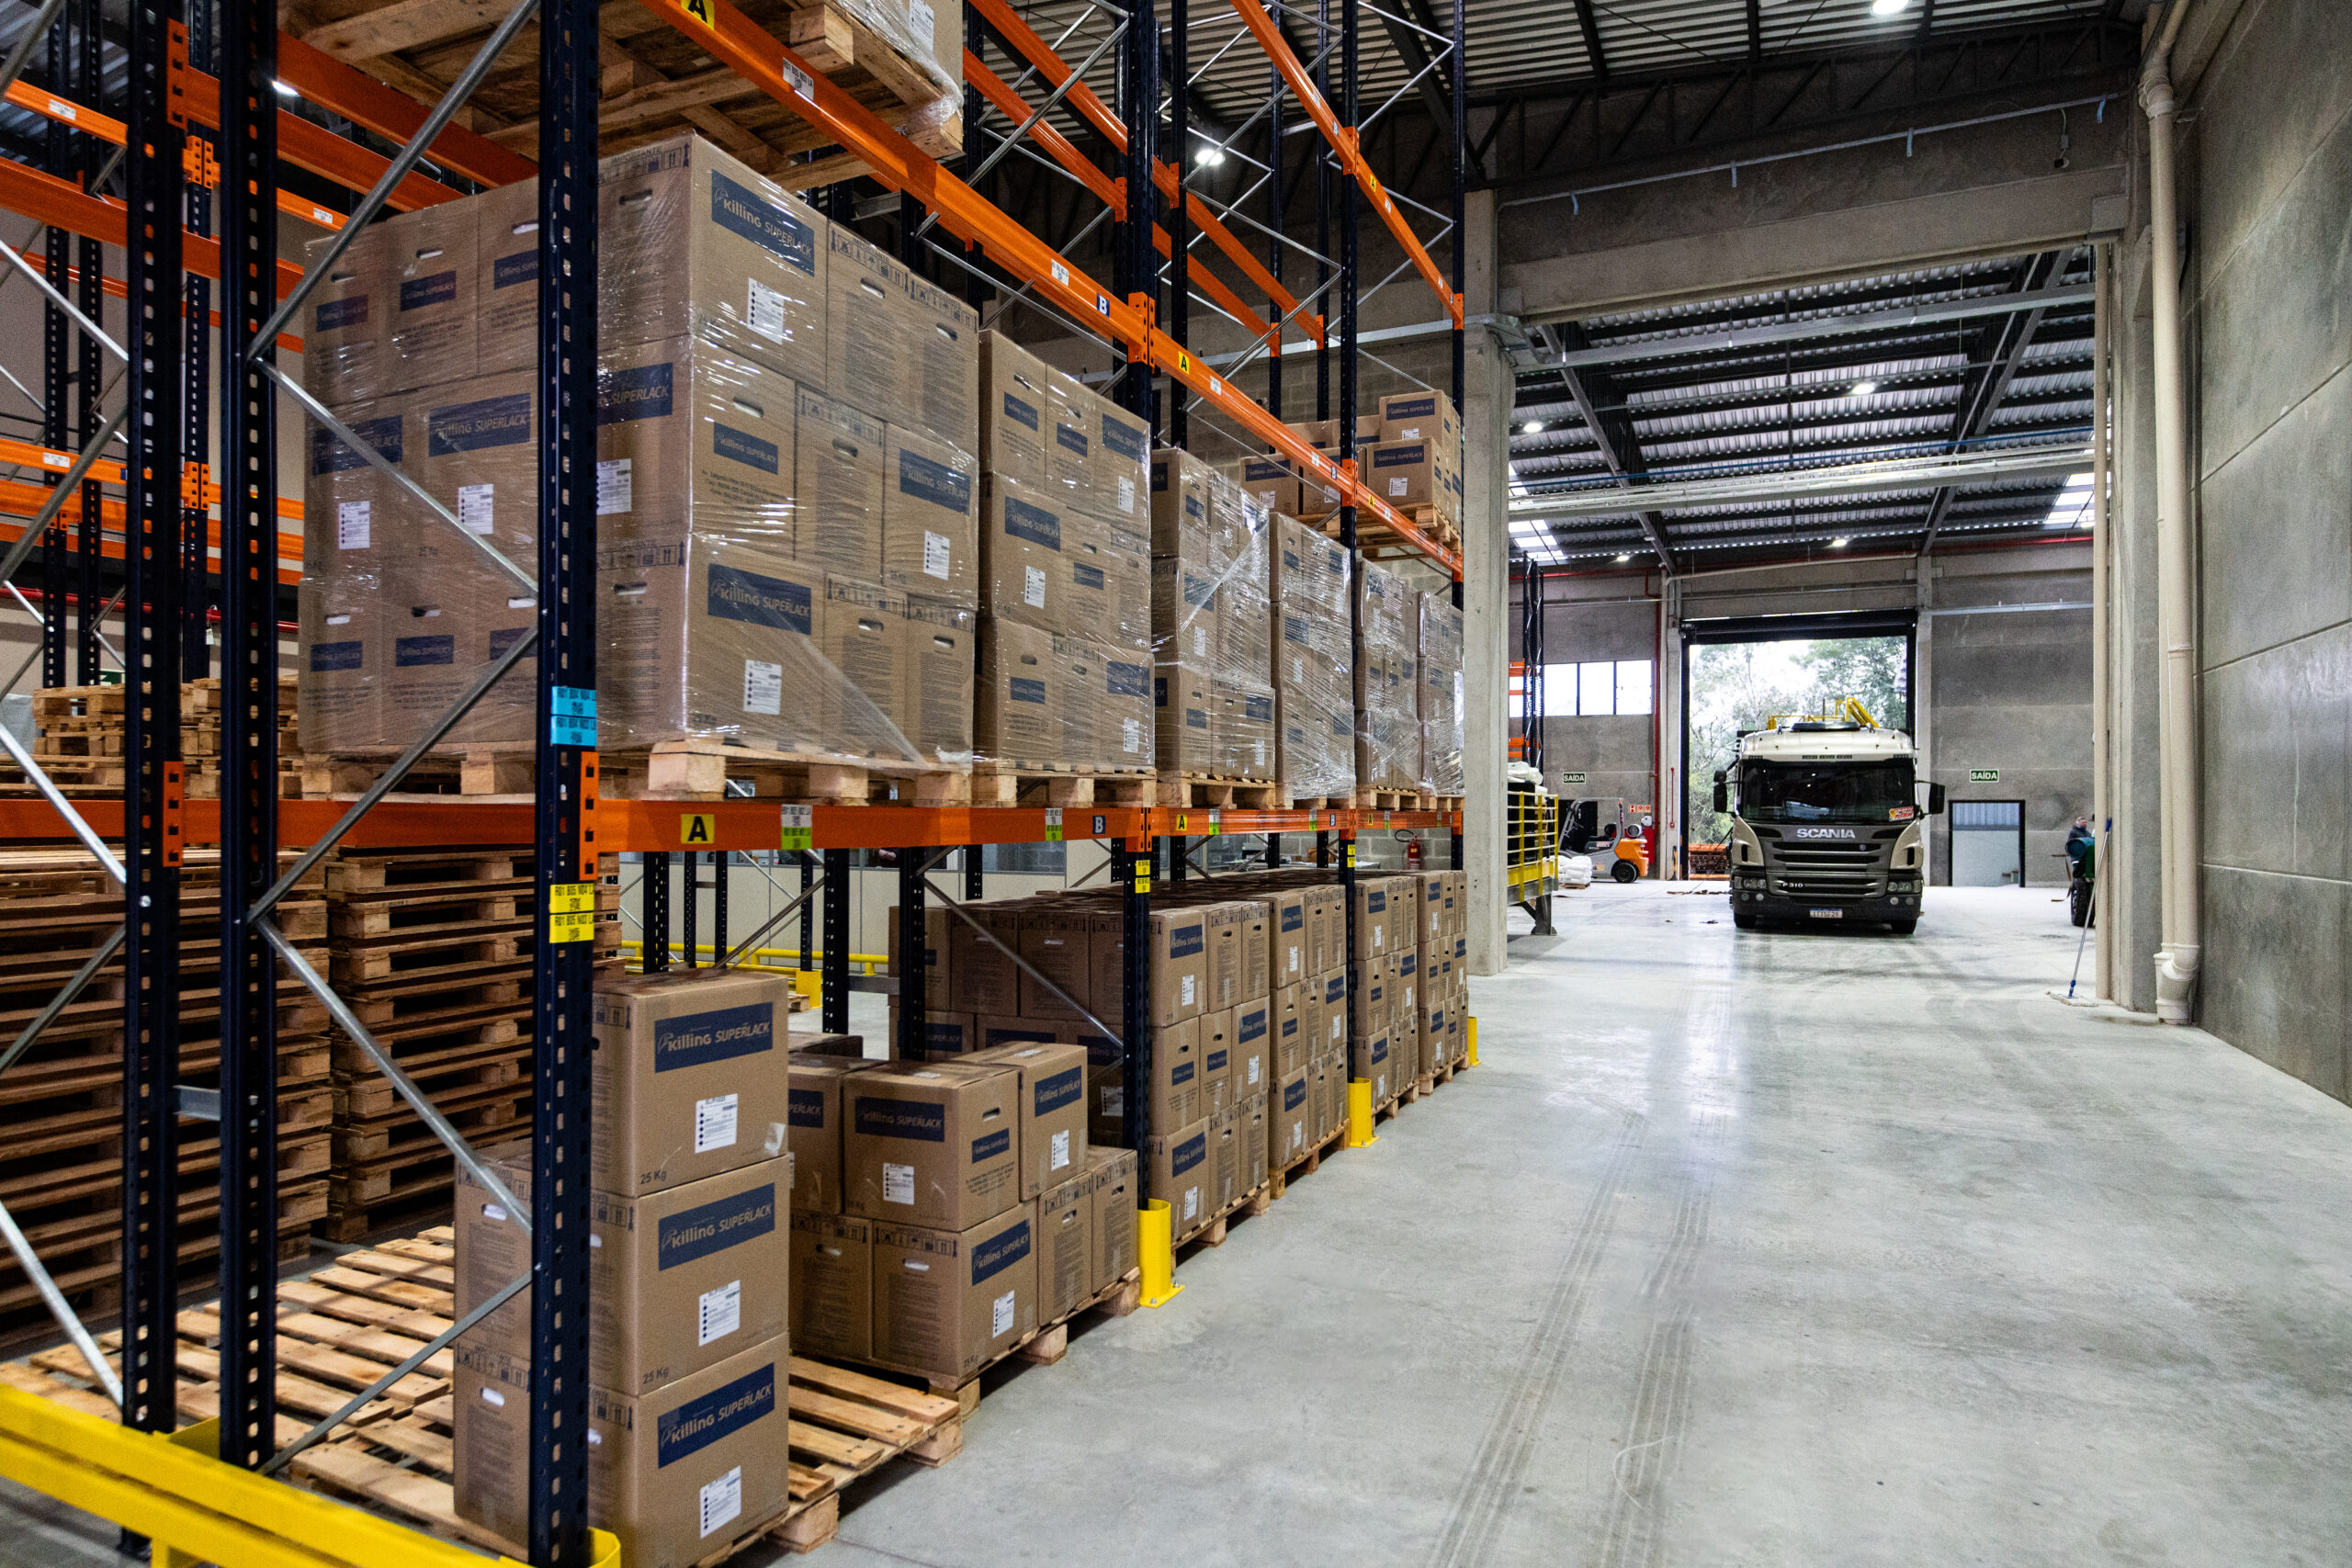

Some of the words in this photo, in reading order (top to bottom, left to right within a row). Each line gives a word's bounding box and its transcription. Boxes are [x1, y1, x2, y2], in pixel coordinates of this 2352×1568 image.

[723, 198, 762, 228] Killing
[764, 221, 813, 256] SUPERLACK
[1099, 295, 1107, 315] B
[1181, 355, 1188, 372] A
[611, 386, 669, 404] SUPERLACK
[475, 413, 527, 433] SUPERLACK
[364, 434, 401, 449] PERLACK
[720, 587, 761, 608] Killing
[763, 597, 809, 618] SUPERLACK
[1564, 773, 1585, 782] SAÍDA
[1971, 771, 1997, 780] SAÍDA
[687, 816, 707, 841] A
[1094, 816, 1103, 834] B
[1178, 815, 1185, 829] A
[1796, 828, 1856, 839] SCANIA
[668, 1031, 712, 1052] Killing
[715, 1021, 771, 1043] SUPERLACK
[787, 1103, 821, 1116] PERLACK
[863, 1110, 895, 1125] Killing
[897, 1114, 942, 1130] SUPERLACK
[640, 1173, 651, 1185] 25
[653, 1170, 667, 1182] Kg
[672, 1224, 716, 1249] Killing
[718, 1202, 773, 1234] SUPERLACK
[978, 1250, 1001, 1270] Killing
[1001, 1234, 1029, 1257] SUPERLACK
[643, 1371, 654, 1384] 25
[656, 1367, 669, 1380] Kg
[671, 1413, 716, 1445] Killing
[718, 1382, 773, 1422] SUPERLACK
